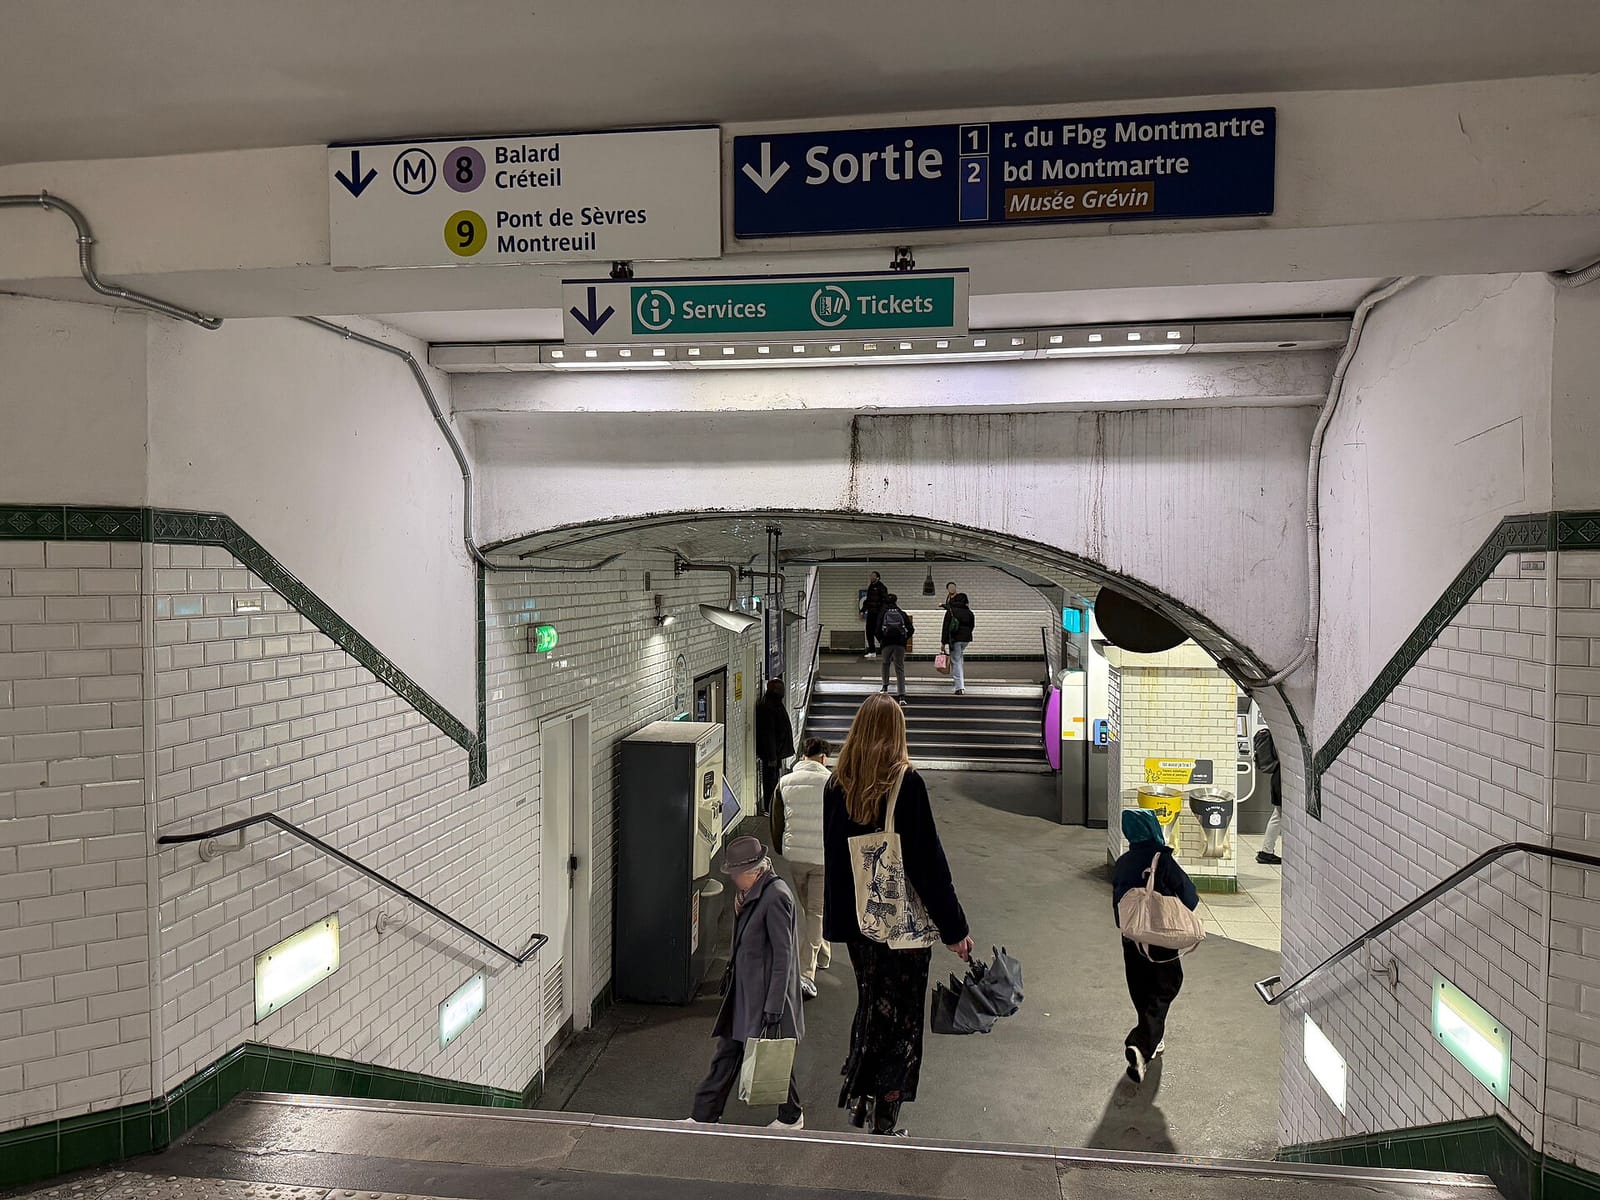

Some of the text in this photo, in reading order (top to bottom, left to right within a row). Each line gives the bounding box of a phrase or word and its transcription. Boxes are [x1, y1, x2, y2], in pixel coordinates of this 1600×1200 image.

[967, 130, 979, 150] 1
[1004, 117, 1265, 149] r. du Fbg Montmartre
[495, 142, 560, 164] Balard
[805, 139, 943, 185] Sortie
[403, 158, 427, 185] M
[455, 155, 474, 184] 8
[495, 167, 561, 189] Créteil
[967, 162, 981, 183] 2
[1003, 155, 1190, 182] bd Montmartre
[1009, 187, 1149, 213] Musée Grévin
[496, 206, 647, 229] Pont de Sèvres
[456, 220, 475, 248] 9
[497, 231, 596, 253] Montreuil
[682, 299, 767, 320] Services
[856, 294, 933, 315] Tickets
